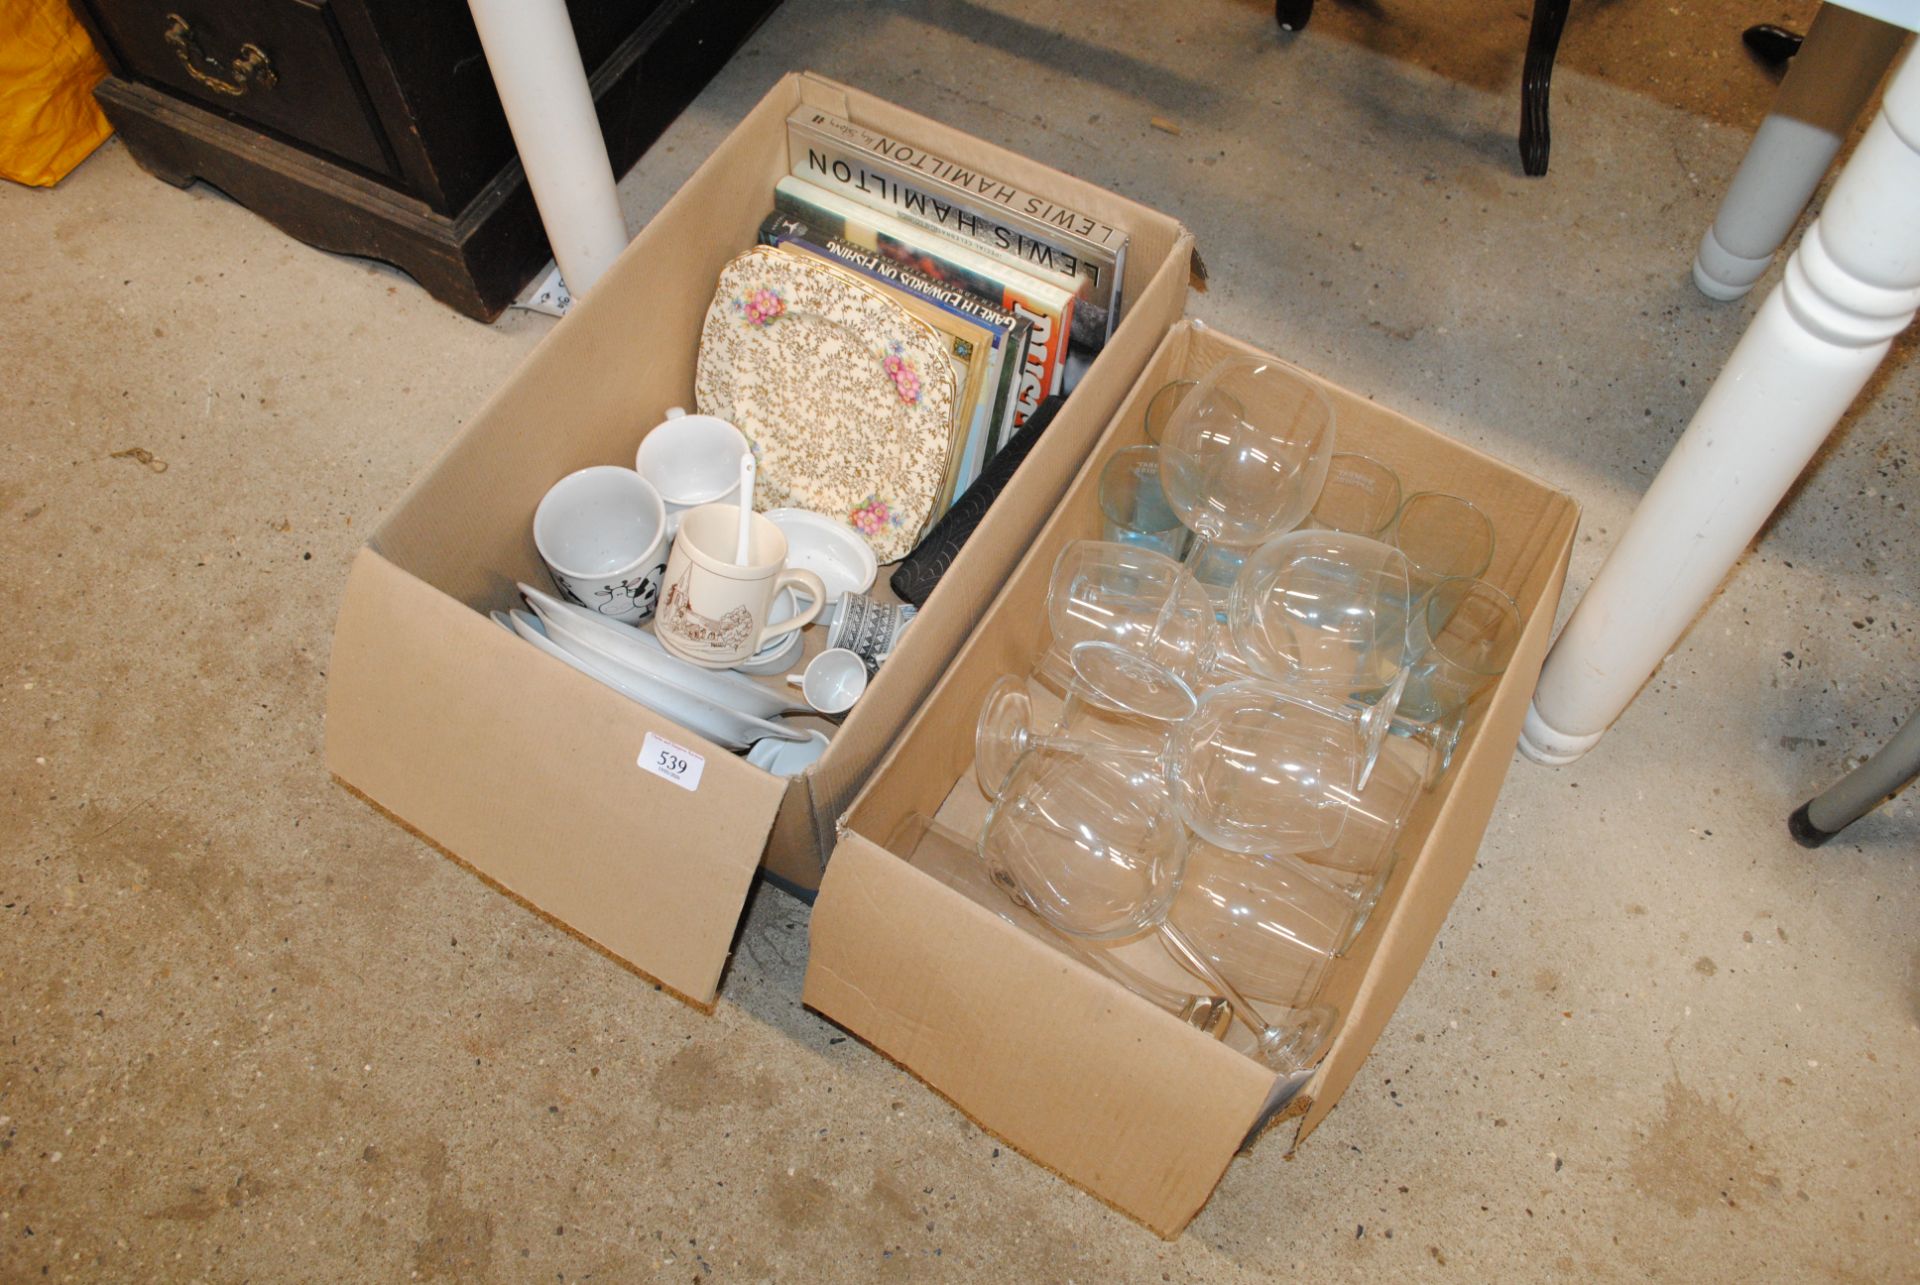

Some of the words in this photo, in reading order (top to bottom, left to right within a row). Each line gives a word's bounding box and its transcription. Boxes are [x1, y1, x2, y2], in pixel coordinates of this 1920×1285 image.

[873, 138, 1016, 203] HAMILTON
[808, 149, 978, 236] HAMILTON
[1024, 198, 1113, 243] LEWIS
[826, 241, 879, 270] FISHING
[877, 265, 898, 280] ON
[994, 226, 1100, 287] LEWIS
[900, 272, 963, 310] EDWARDS
[961, 301, 1017, 331] GARETH
[657, 750, 687, 774] 539
